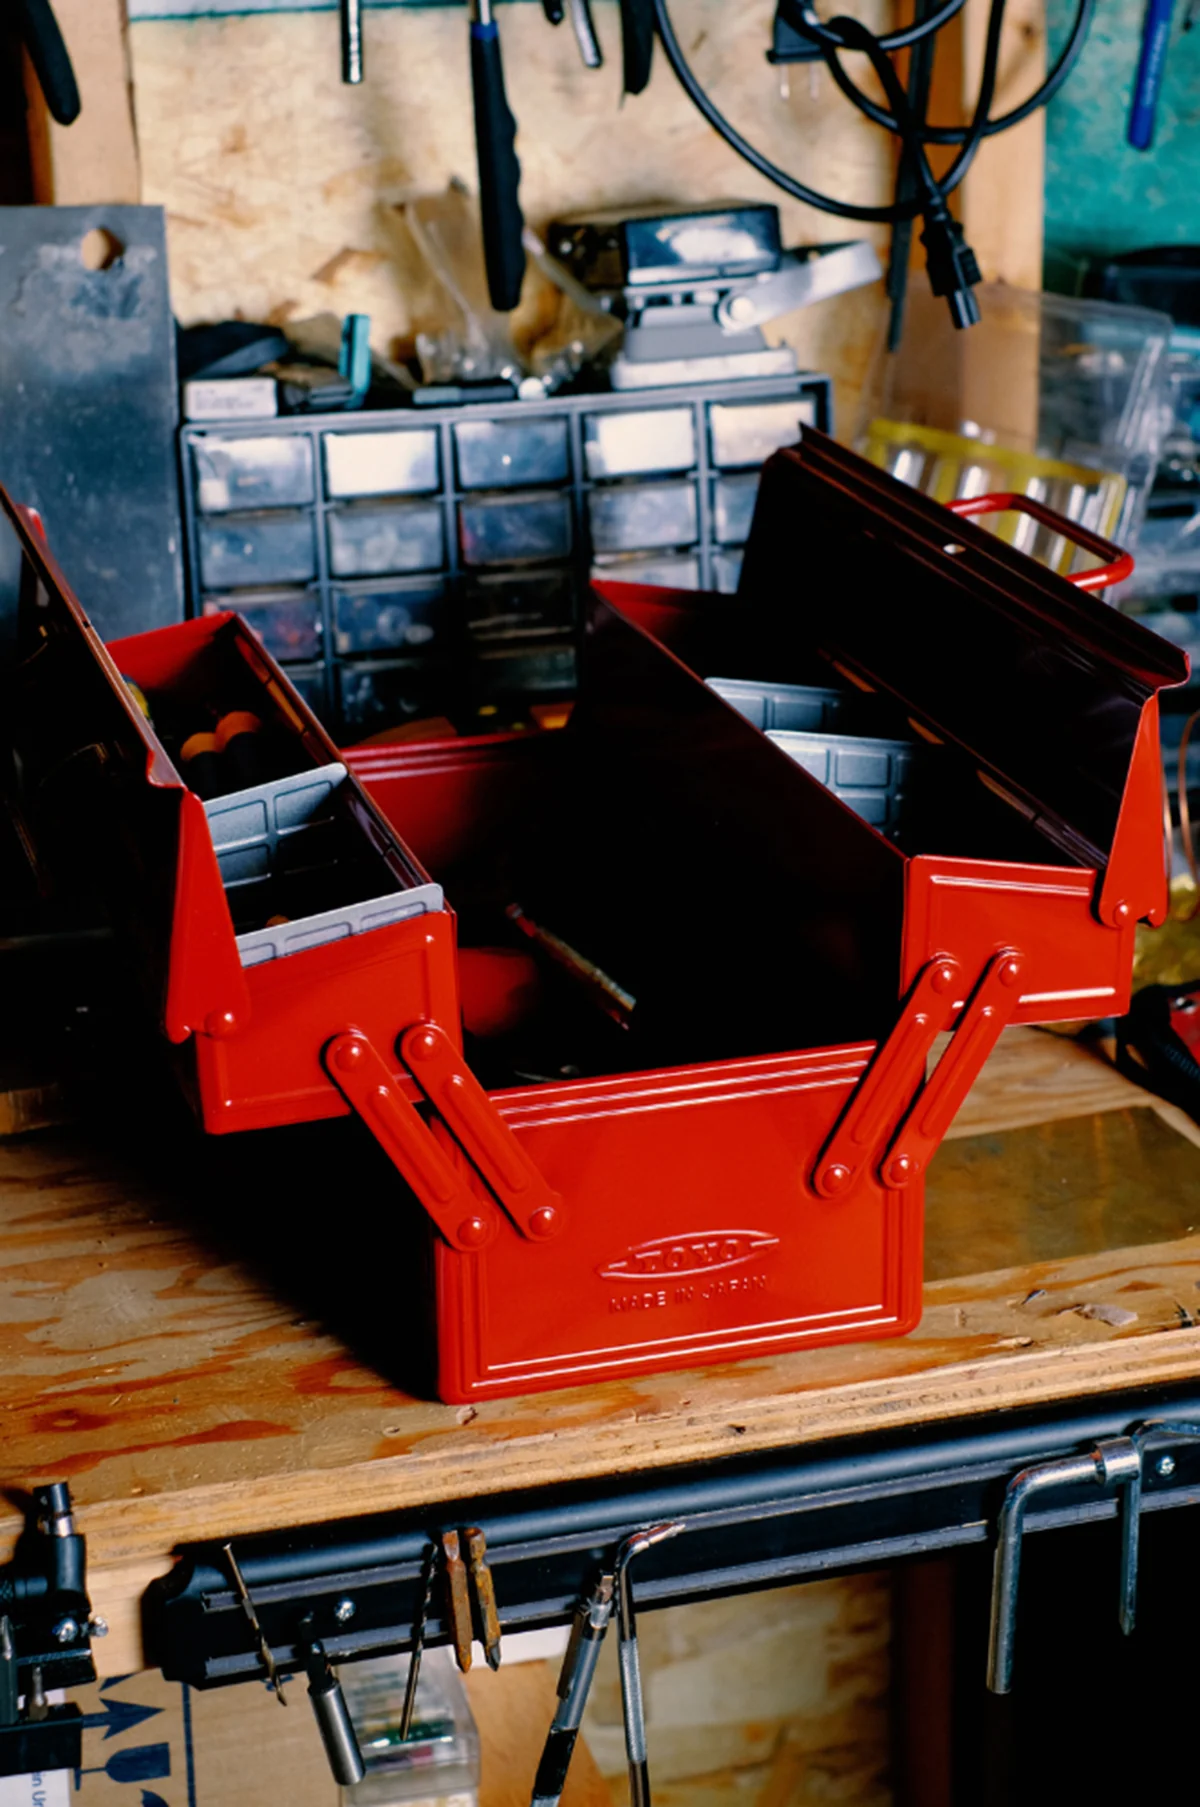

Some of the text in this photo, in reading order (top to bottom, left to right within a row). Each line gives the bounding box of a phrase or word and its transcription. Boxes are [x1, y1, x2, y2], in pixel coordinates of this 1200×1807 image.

[634, 1239, 740, 1272] TOYO
[609, 1274, 768, 1314] MADE IN JAPAN
